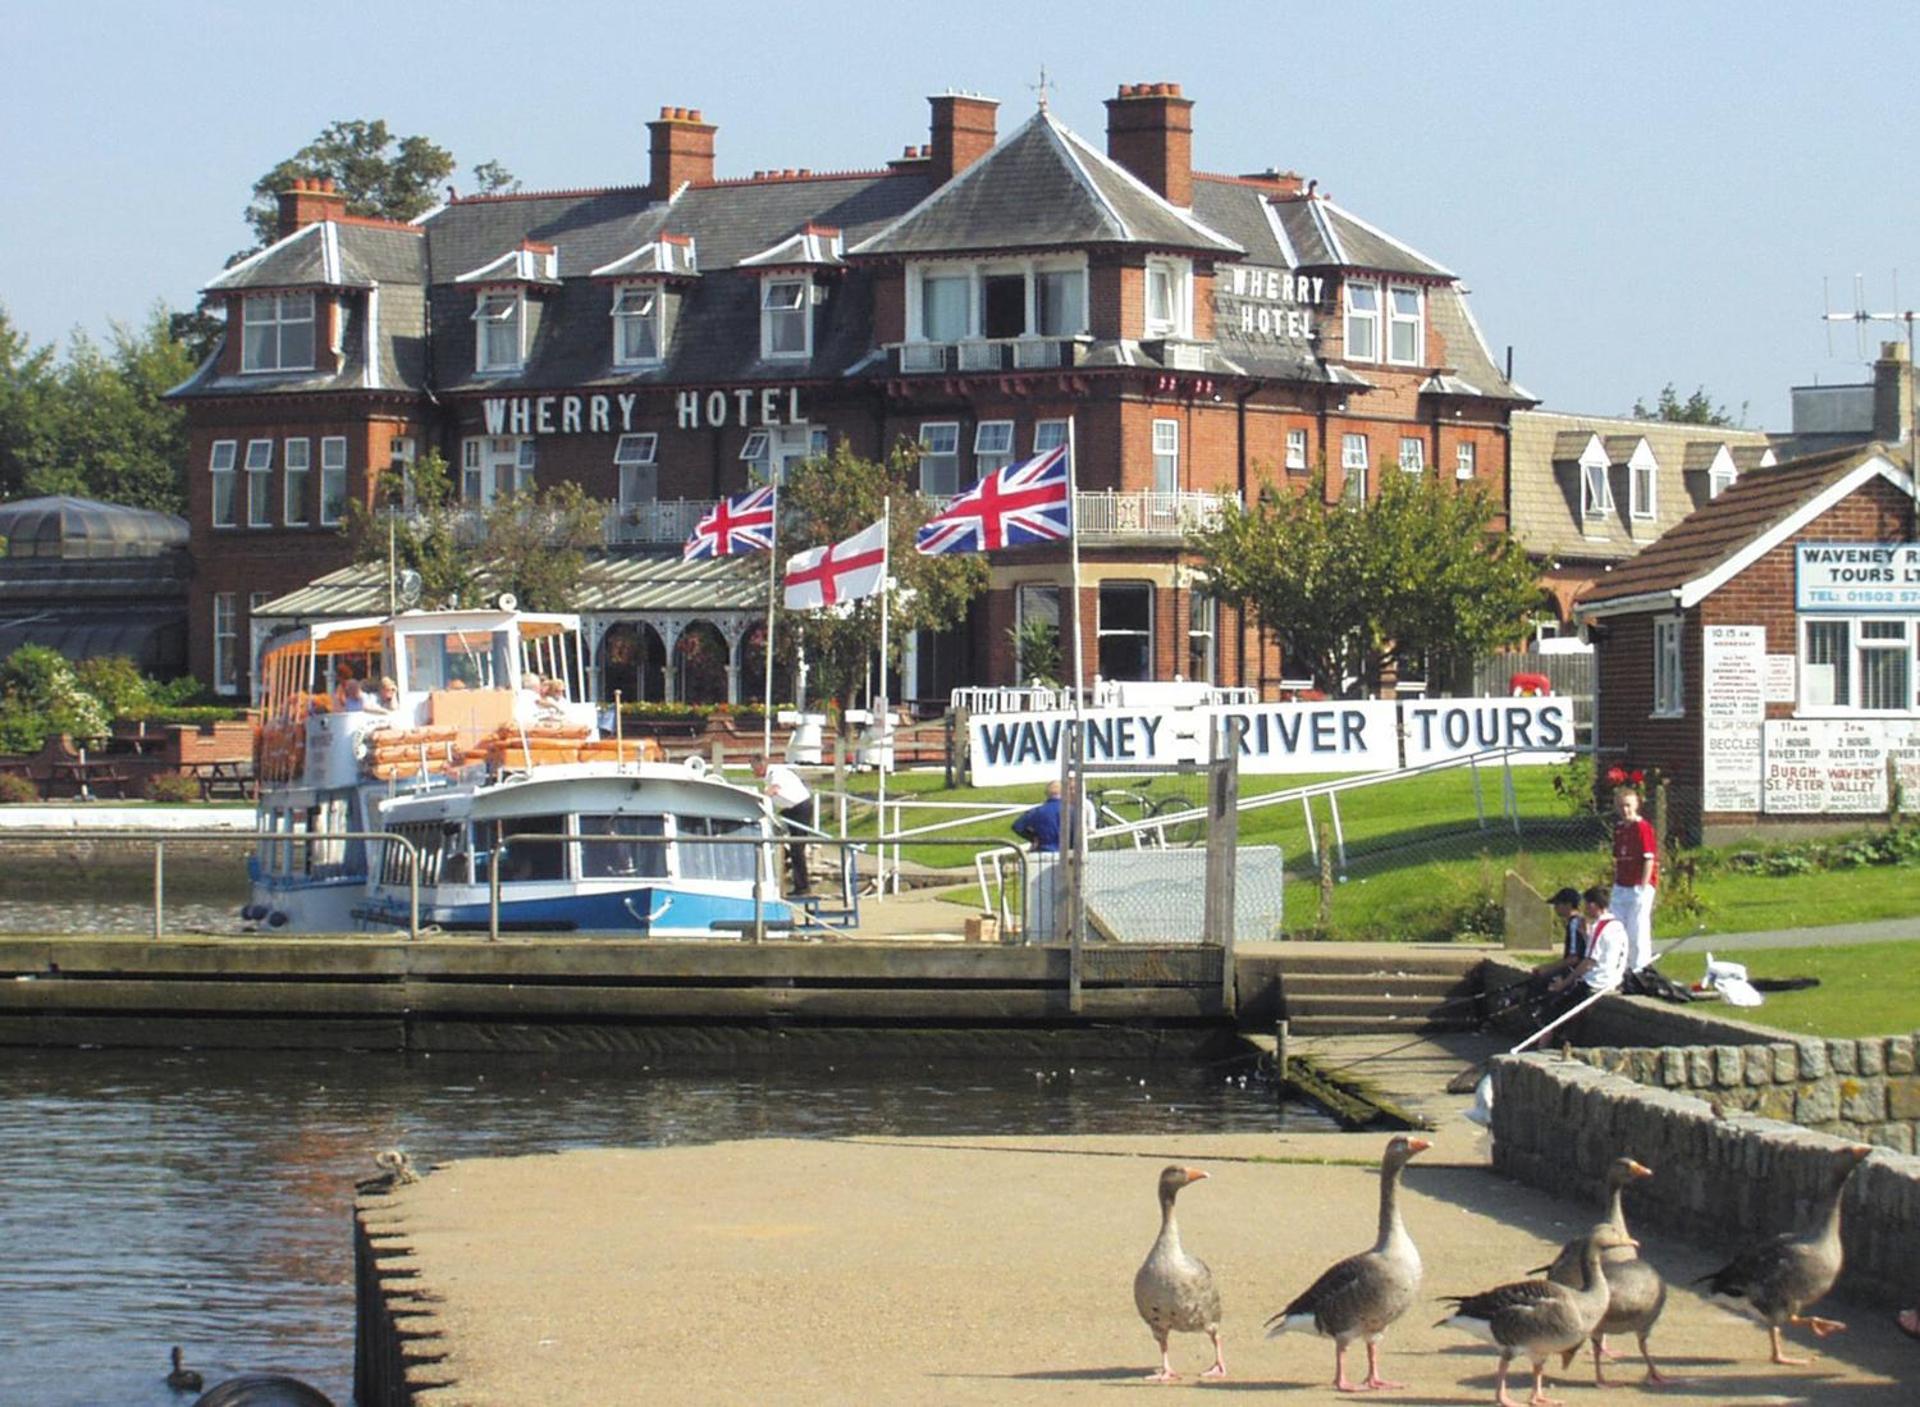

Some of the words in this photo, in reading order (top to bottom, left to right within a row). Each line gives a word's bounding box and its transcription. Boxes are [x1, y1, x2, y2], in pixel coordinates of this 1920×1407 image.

[1233, 268, 1323, 304] WHERRY
[1241, 304, 1316, 339] HOTEL
[482, 393, 637, 434] WHERRY
[677, 387, 808, 429] HOTEL
[1804, 549, 1896, 563] WAVENEY
[1829, 568, 1895, 582] TOURS
[1808, 591, 1840, 601] TEL:
[1846, 590, 1894, 602] 01502
[1226, 709, 1368, 756] RIVER
[1412, 705, 1564, 751] TOURS
[1709, 738, 1761, 750] BECCLES
[1768, 749, 1796, 759] RIVER
[1798, 749, 1821, 759] TRIP
[1828, 749, 1856, 759] RIVER
[1827, 768, 1882, 779] WAVENEY
[1786, 778, 1825, 791] PETER
[1831, 780, 1875, 792] VALLEY
